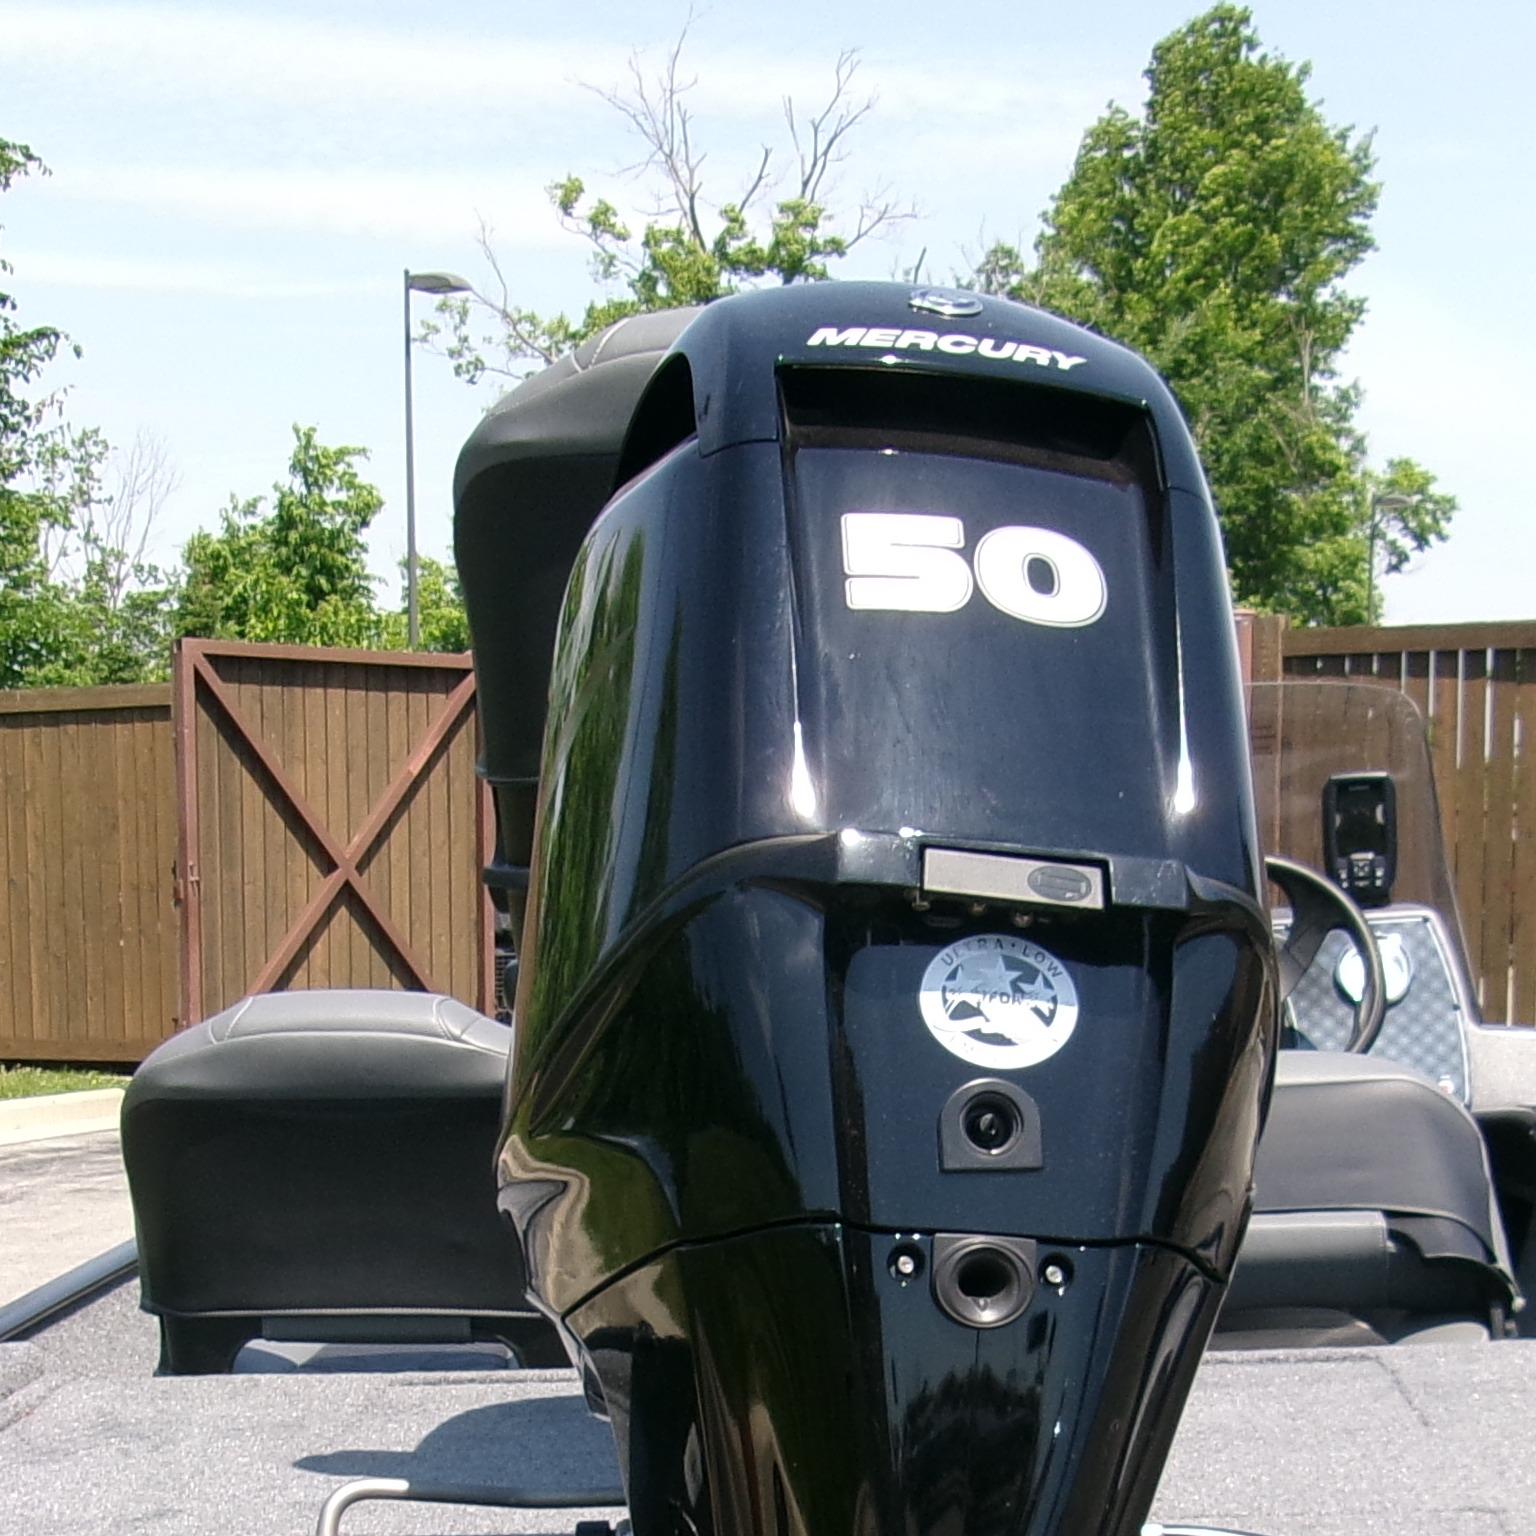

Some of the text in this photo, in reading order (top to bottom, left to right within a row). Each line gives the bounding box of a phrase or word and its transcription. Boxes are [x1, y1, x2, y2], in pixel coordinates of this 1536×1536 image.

[807, 327, 1089, 370] MERCURY
[841, 512, 1108, 628] 50
[1021, 944, 1064, 979] LOW
